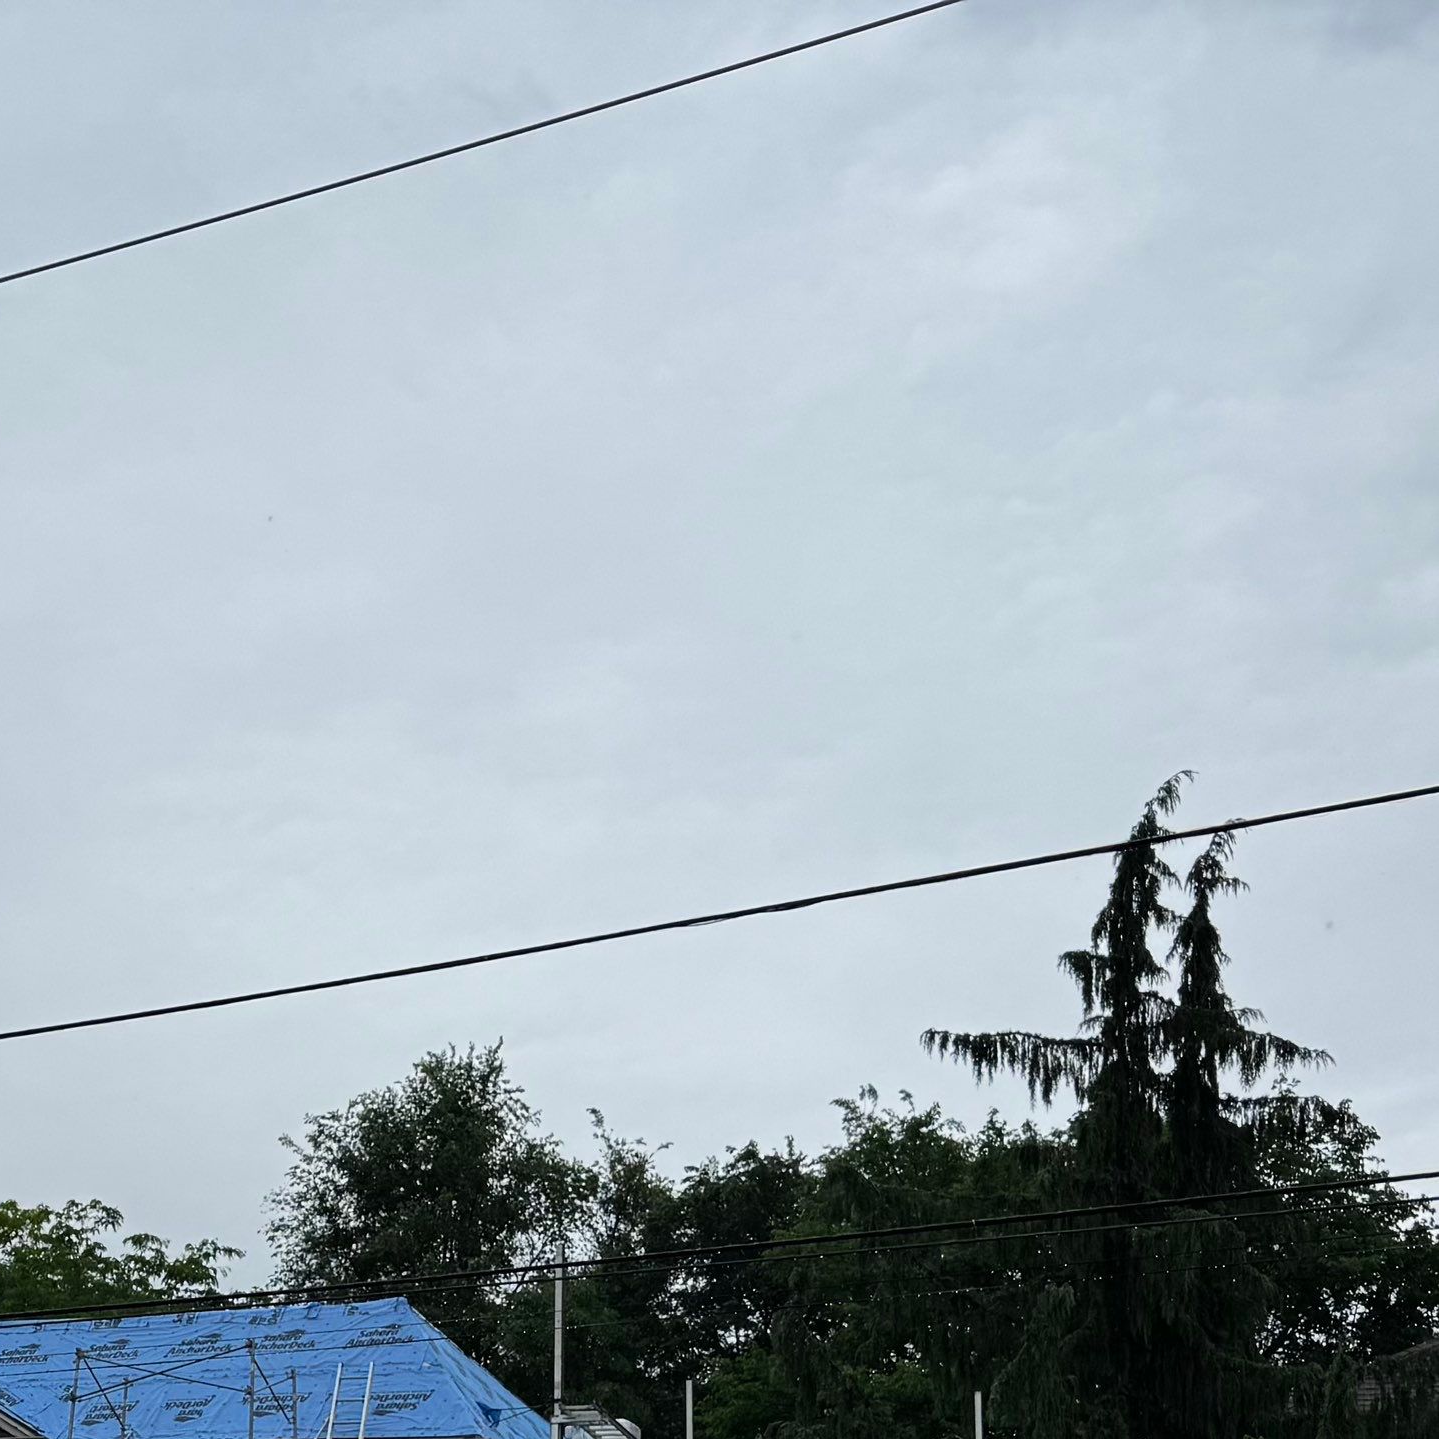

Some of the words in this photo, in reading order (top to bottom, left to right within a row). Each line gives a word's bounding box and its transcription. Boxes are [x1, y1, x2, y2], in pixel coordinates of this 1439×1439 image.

[262, 1333, 302, 1342] Sahara
[359, 1328, 399, 1338] Sahara
[0, 1348, 38, 1357] Sahara
[375, 1401, 419, 1411] Sahara
